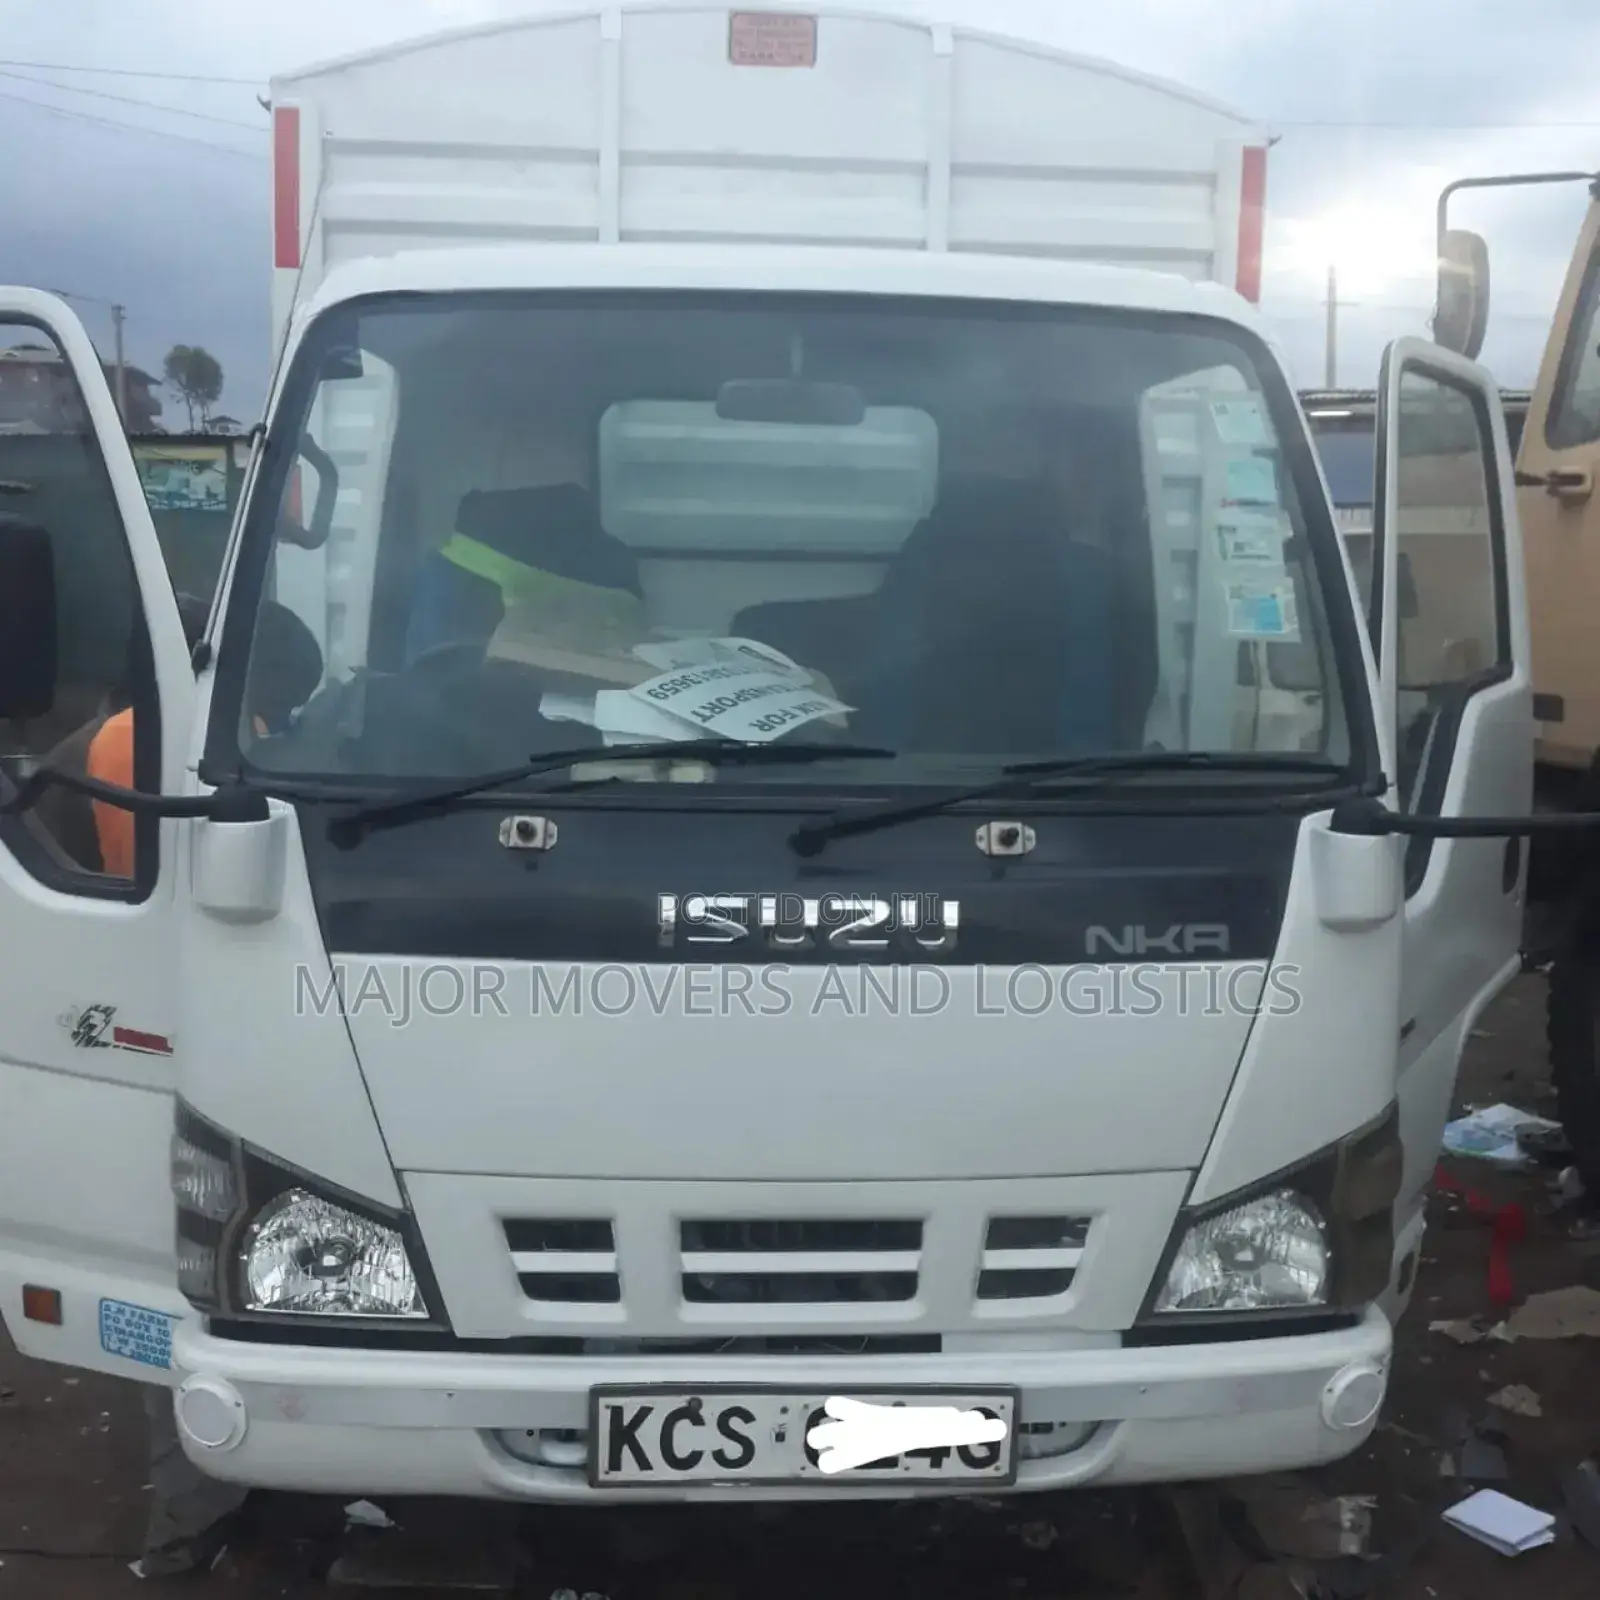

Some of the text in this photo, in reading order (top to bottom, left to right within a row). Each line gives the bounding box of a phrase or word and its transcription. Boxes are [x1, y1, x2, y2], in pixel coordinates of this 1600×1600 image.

[749, 709, 797, 733] FOR
[658, 896, 960, 949] ISUZU
[608, 1402, 757, 1472] KCS
